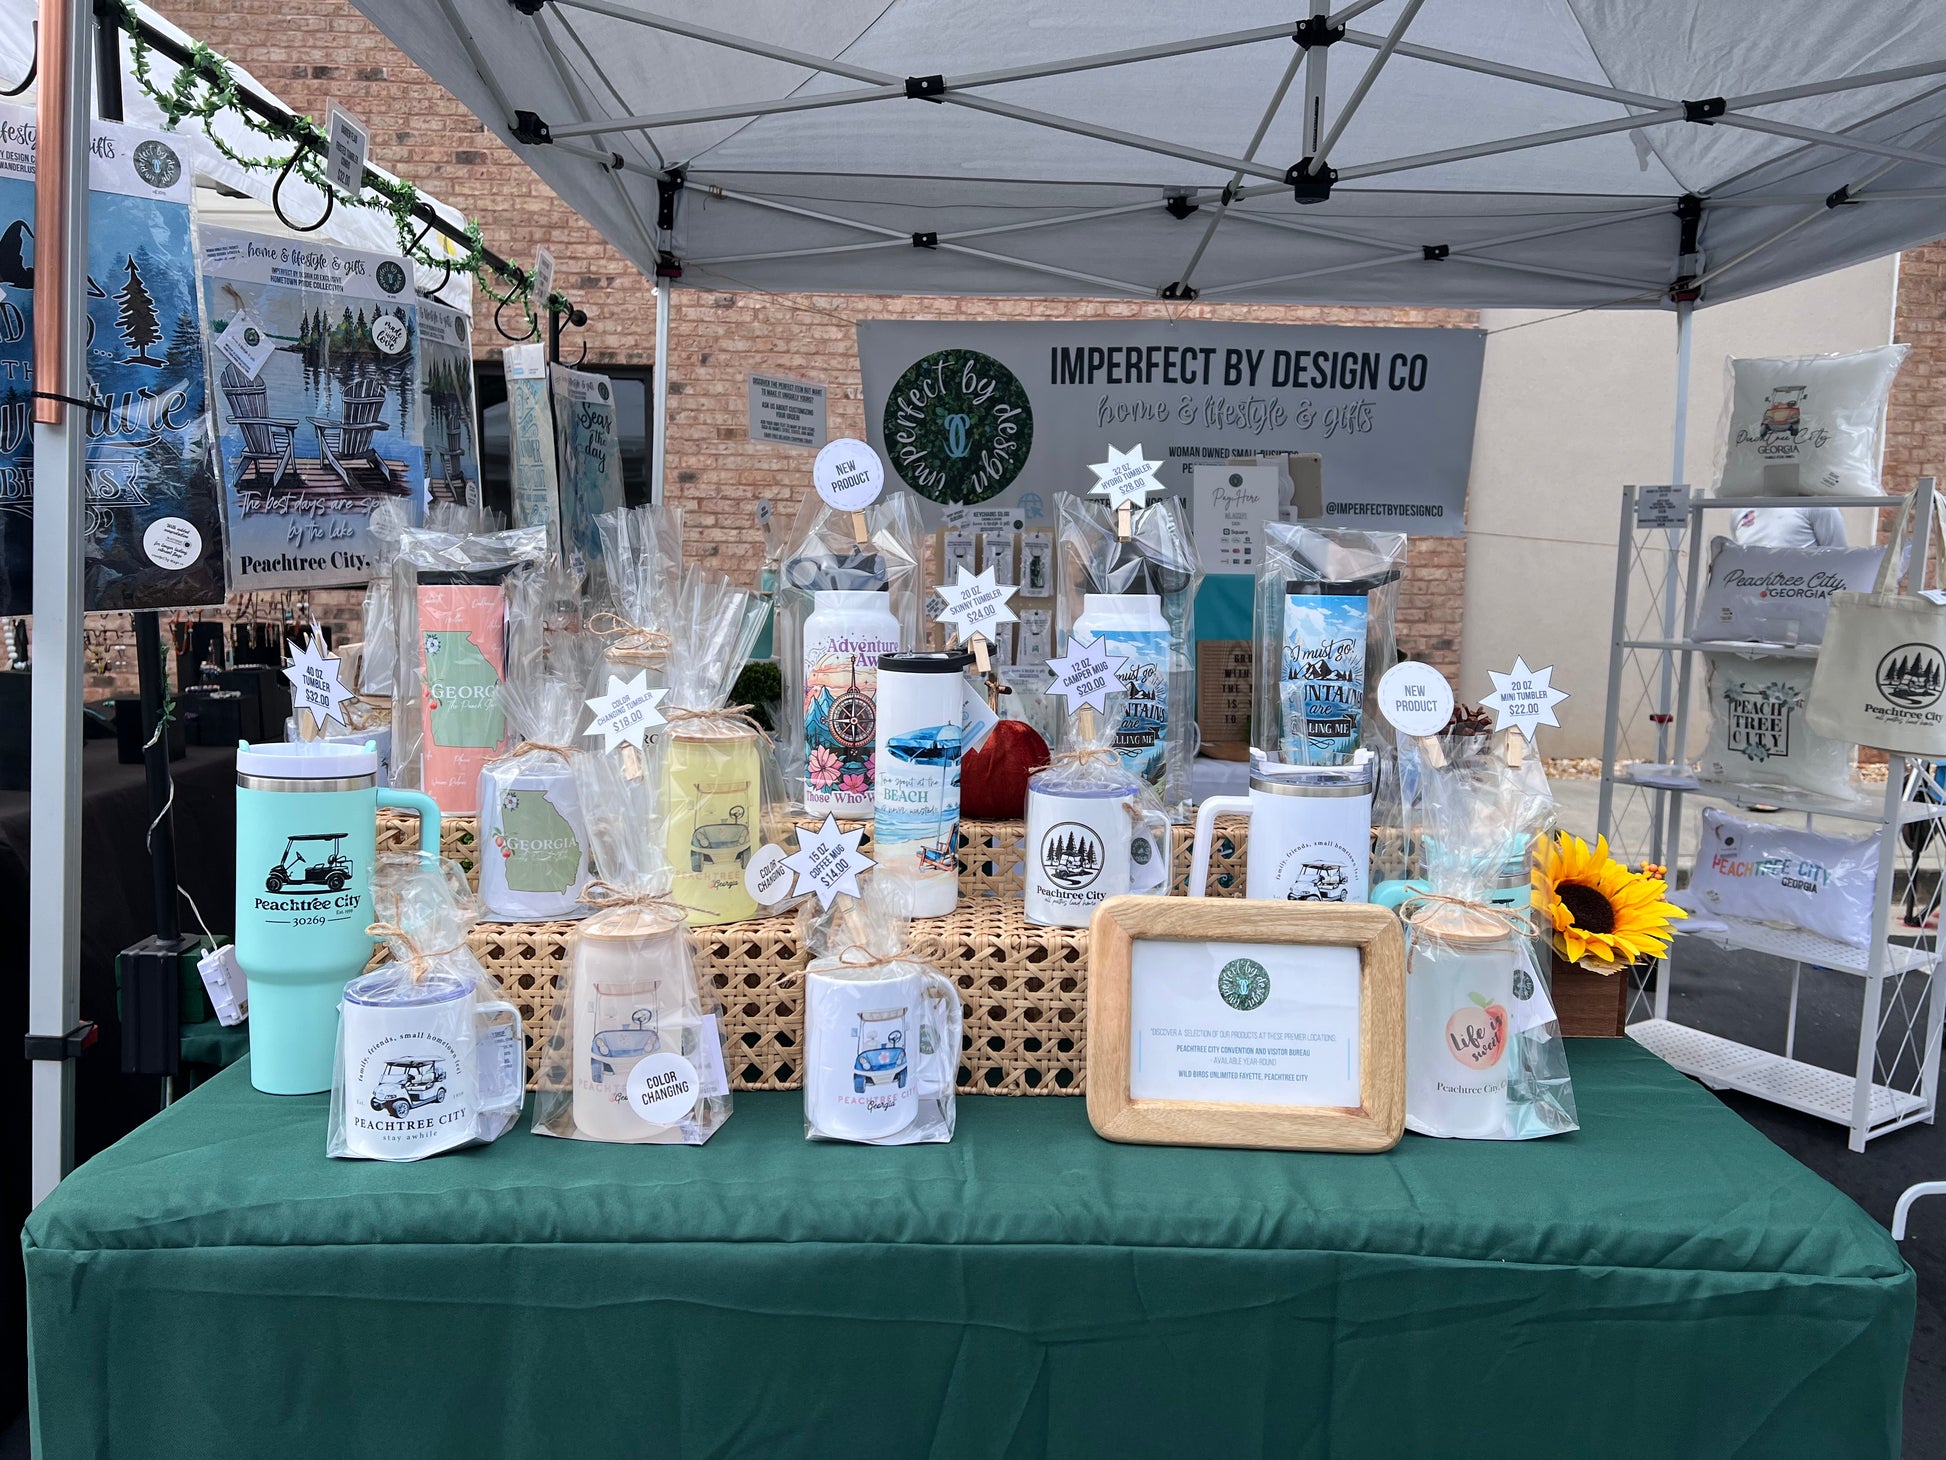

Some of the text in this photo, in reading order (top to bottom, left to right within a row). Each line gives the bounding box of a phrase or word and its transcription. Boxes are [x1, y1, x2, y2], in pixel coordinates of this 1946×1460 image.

[248, 242, 277, 260] home
[281, 248, 289, 263] &
[292, 249, 328, 271] lifestyle
[332, 256, 340, 271] &
[344, 259, 366, 276] gifts
[270, 275, 344, 292] HOMETOWN COLLECTION
[384, 321, 402, 338] made
[377, 334, 396, 351] love
[1051, 346, 1429, 392] IMPERFECT BY DESIGN CO
[578, 402, 612, 430] Seas
[1095, 394, 1377, 439] home & lifestyle & gifts
[896, 358, 1023, 497] imperfect by design
[591, 429, 608, 447] the
[1793, 428, 1832, 448] City
[584, 436, 606, 473] day
[1169, 446, 1230, 459] WOMAN OWNED
[1757, 445, 1800, 455] GEORGIA
[835, 459, 856, 476] NEW
[1111, 463, 1132, 476] 32 OZ
[831, 471, 870, 493] PRODUCT
[1101, 463, 1152, 490] HYDRO TUMBLER
[1118, 478, 1145, 494] $28.00
[236, 490, 261, 519] The
[265, 489, 297, 515] best
[294, 492, 325, 518] days
[330, 498, 353, 510] are
[1212, 488, 1232, 511] Pay
[1234, 488, 1261, 508] Here
[1326, 502, 1443, 518] @IMPERFECTBYDESIGNCO
[287, 518, 354, 547] by the lake
[240, 550, 371, 575] Peachtree City,
[1723, 568, 1847, 592] Peachtree City,
[950, 601, 973, 615] SKINNY
[972, 588, 1003, 606] TUMBLER
[960, 586, 982, 600] 20 OZ
[1769, 588, 1826, 600] GEORGIA
[966, 605, 996, 623] $24.00
[827, 638, 899, 653] Adventure
[1302, 639, 1357, 662] must go!
[306, 665, 324, 680] 40 OZ
[1063, 669, 1093, 687] CAMPER
[1092, 661, 1109, 676] MUG
[1071, 658, 1092, 673] 12 OZ
[302, 674, 331, 693] TUMBLER
[1076, 677, 1106, 696] $20.00
[1404, 685, 1425, 697] NEW
[1511, 680, 1533, 691] 20 OZ
[305, 688, 330, 707] $32.00
[612, 694, 631, 709] COLOR
[1500, 690, 1548, 702] MINI TUMBLER
[597, 692, 653, 726] CHANGING TUMBLER
[1310, 703, 1333, 715] are
[1396, 700, 1438, 712] PRODUCT
[1509, 703, 1539, 715] $22.00
[1733, 700, 1782, 716] PEACH
[1864, 703, 1923, 720] Peachtree
[1925, 711, 1943, 723] City
[613, 709, 643, 732] $18.00
[1121, 720, 1139, 729] are
[1334, 722, 1351, 734] ME
[1733, 714, 1782, 732] TREE
[1141, 735, 1155, 744] ME
[1733, 730, 1782, 748] CITY
[806, 790, 830, 804] Those
[834, 791, 863, 805] Who
[884, 788, 929, 803] BEACH
[507, 837, 578, 850] GEORGIA
[809, 843, 830, 863] 15 OZ
[809, 844, 845, 879] COFFEE MUG
[760, 859, 777, 879] COLOR
[820, 858, 850, 887] $14.00
[713, 879, 739, 890] Georgia
[757, 865, 786, 893] CHANGING
[1781, 877, 1818, 893] GEORGIA
[1037, 885, 1107, 901] Peachtree City
[255, 894, 361, 912] Peachtree City
[292, 916, 326, 927] 30269
[1245, 961, 1257, 977] by
[1184, 1029, 1211, 1038] SELECTION
[1211, 1030, 1220, 1038] OF
[1219, 1030, 1231, 1039] OUR
[1231, 1031, 1258, 1040] PRODUCTS
[1258, 1032, 1267, 1040] AT
[1267, 1032, 1283, 1040] THESE
[1284, 1032, 1306, 1041] PREMIER
[1450, 1012, 1503, 1052] Life is
[1176, 1044, 1311, 1057] PEACHTREE CITY CONVENTION AND VISITOR BUREAU
[1471, 1031, 1502, 1062] sweet
[358, 1031, 458, 1082] family, friends, small hometown
[1213, 1057, 1242, 1066] AVAILABLE
[646, 1070, 677, 1091] COLOR
[1178, 1070, 1309, 1082] WILD BIRDS UNLIMITED PEACHTREE CITY
[641, 1080, 690, 1106] CHANGING
[838, 1086, 916, 1105] PEACHTREE CITY
[1437, 1082, 1482, 1095] Peachtree
[866, 1100, 896, 1114] Georgia
[354, 1107, 468, 1132] PEACHTREE CITY
[383, 1130, 438, 1143] stay awhile
